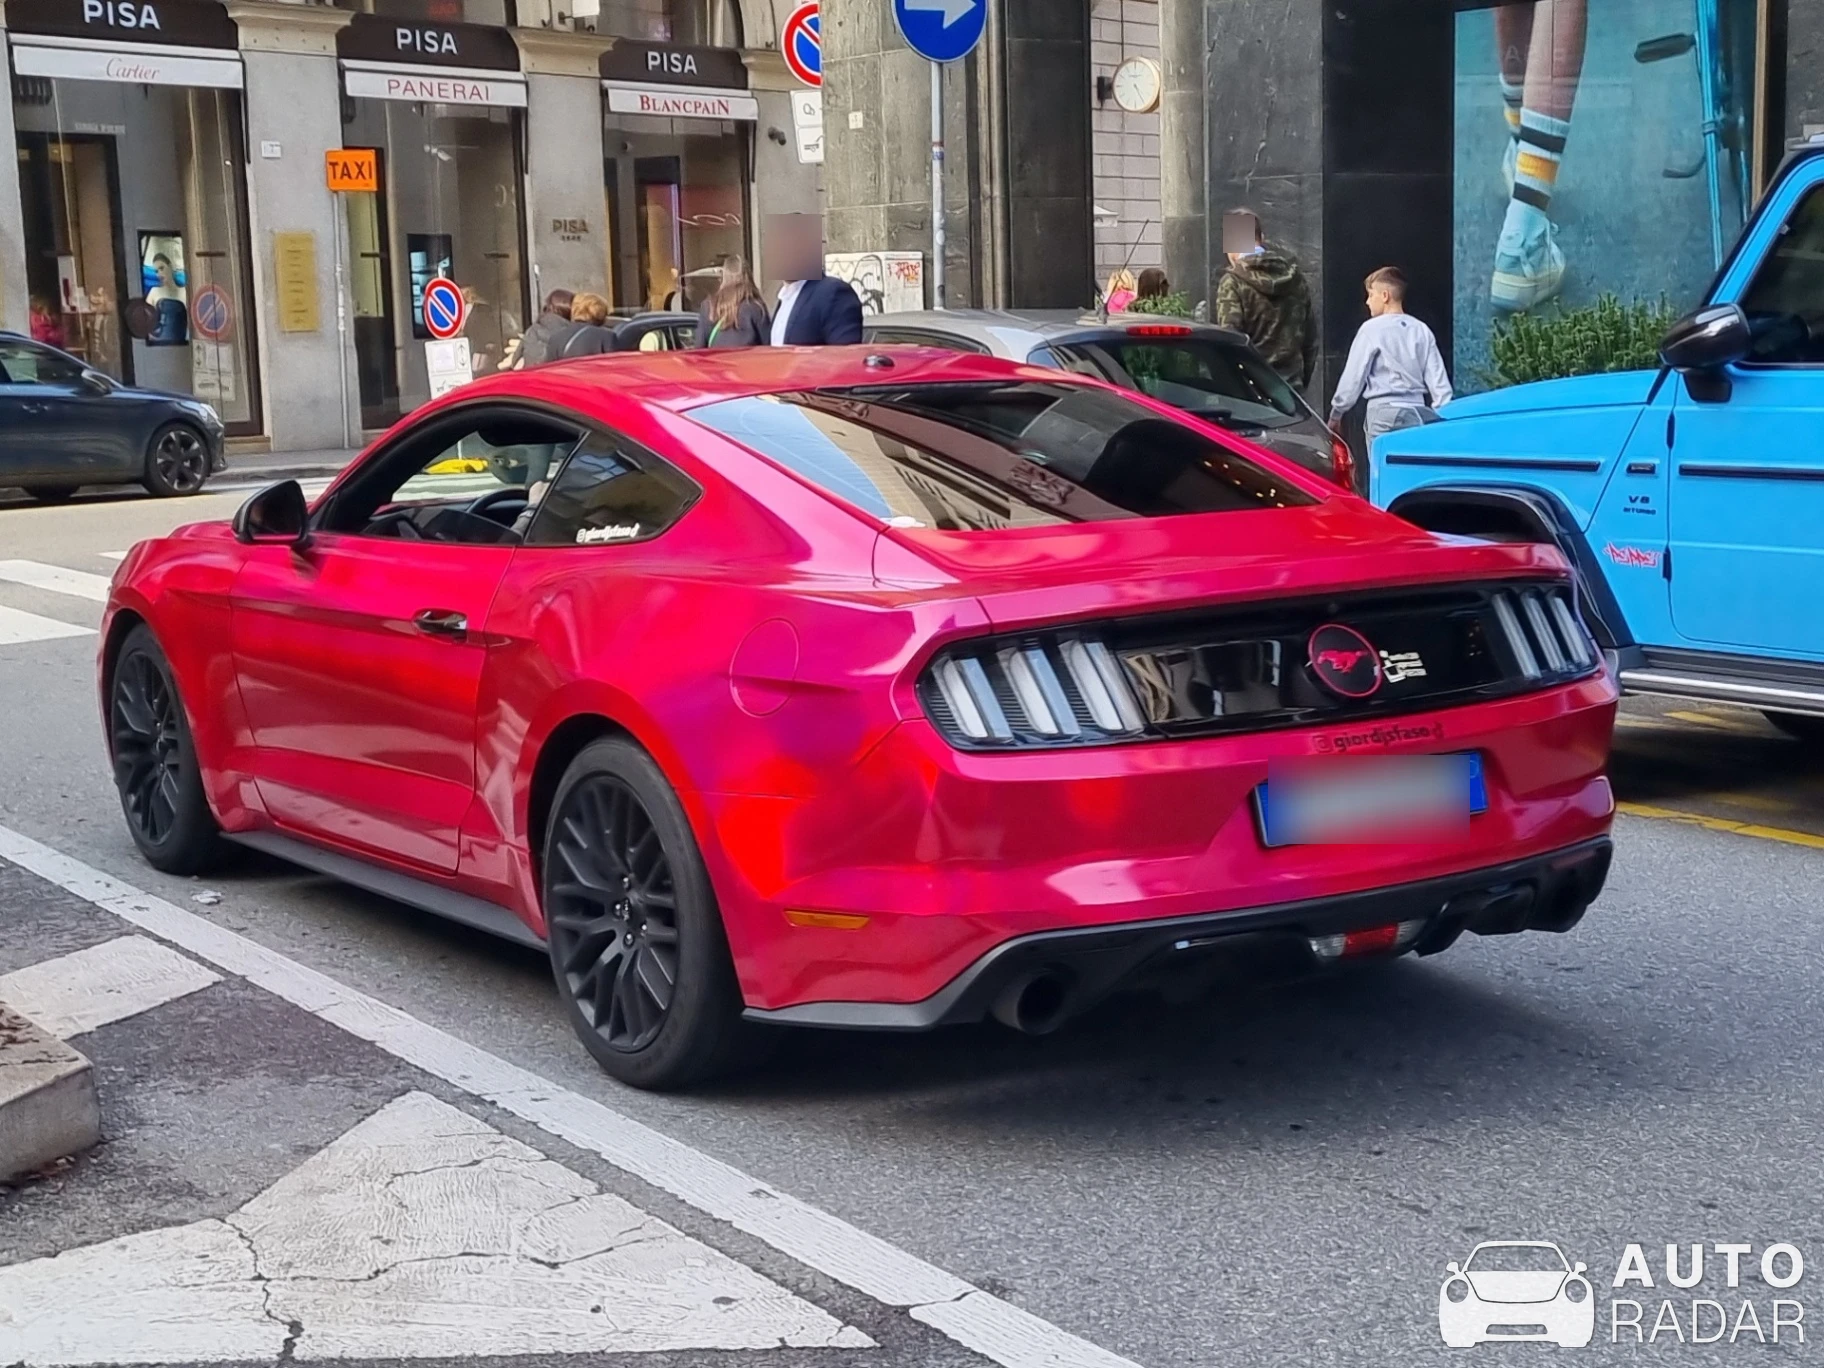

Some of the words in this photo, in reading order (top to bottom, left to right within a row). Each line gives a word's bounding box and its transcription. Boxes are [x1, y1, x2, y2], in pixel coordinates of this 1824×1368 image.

[83, 0, 161, 30] PISA
[396, 28, 458, 55] PISA
[106, 57, 160, 80] Cartier
[647, 51, 698, 75] PISA
[387, 79, 490, 101] PANERAI
[640, 94, 730, 115] BLANCPAIN
[328, 160, 373, 180] TAXI
[552, 219, 589, 233] PISA
